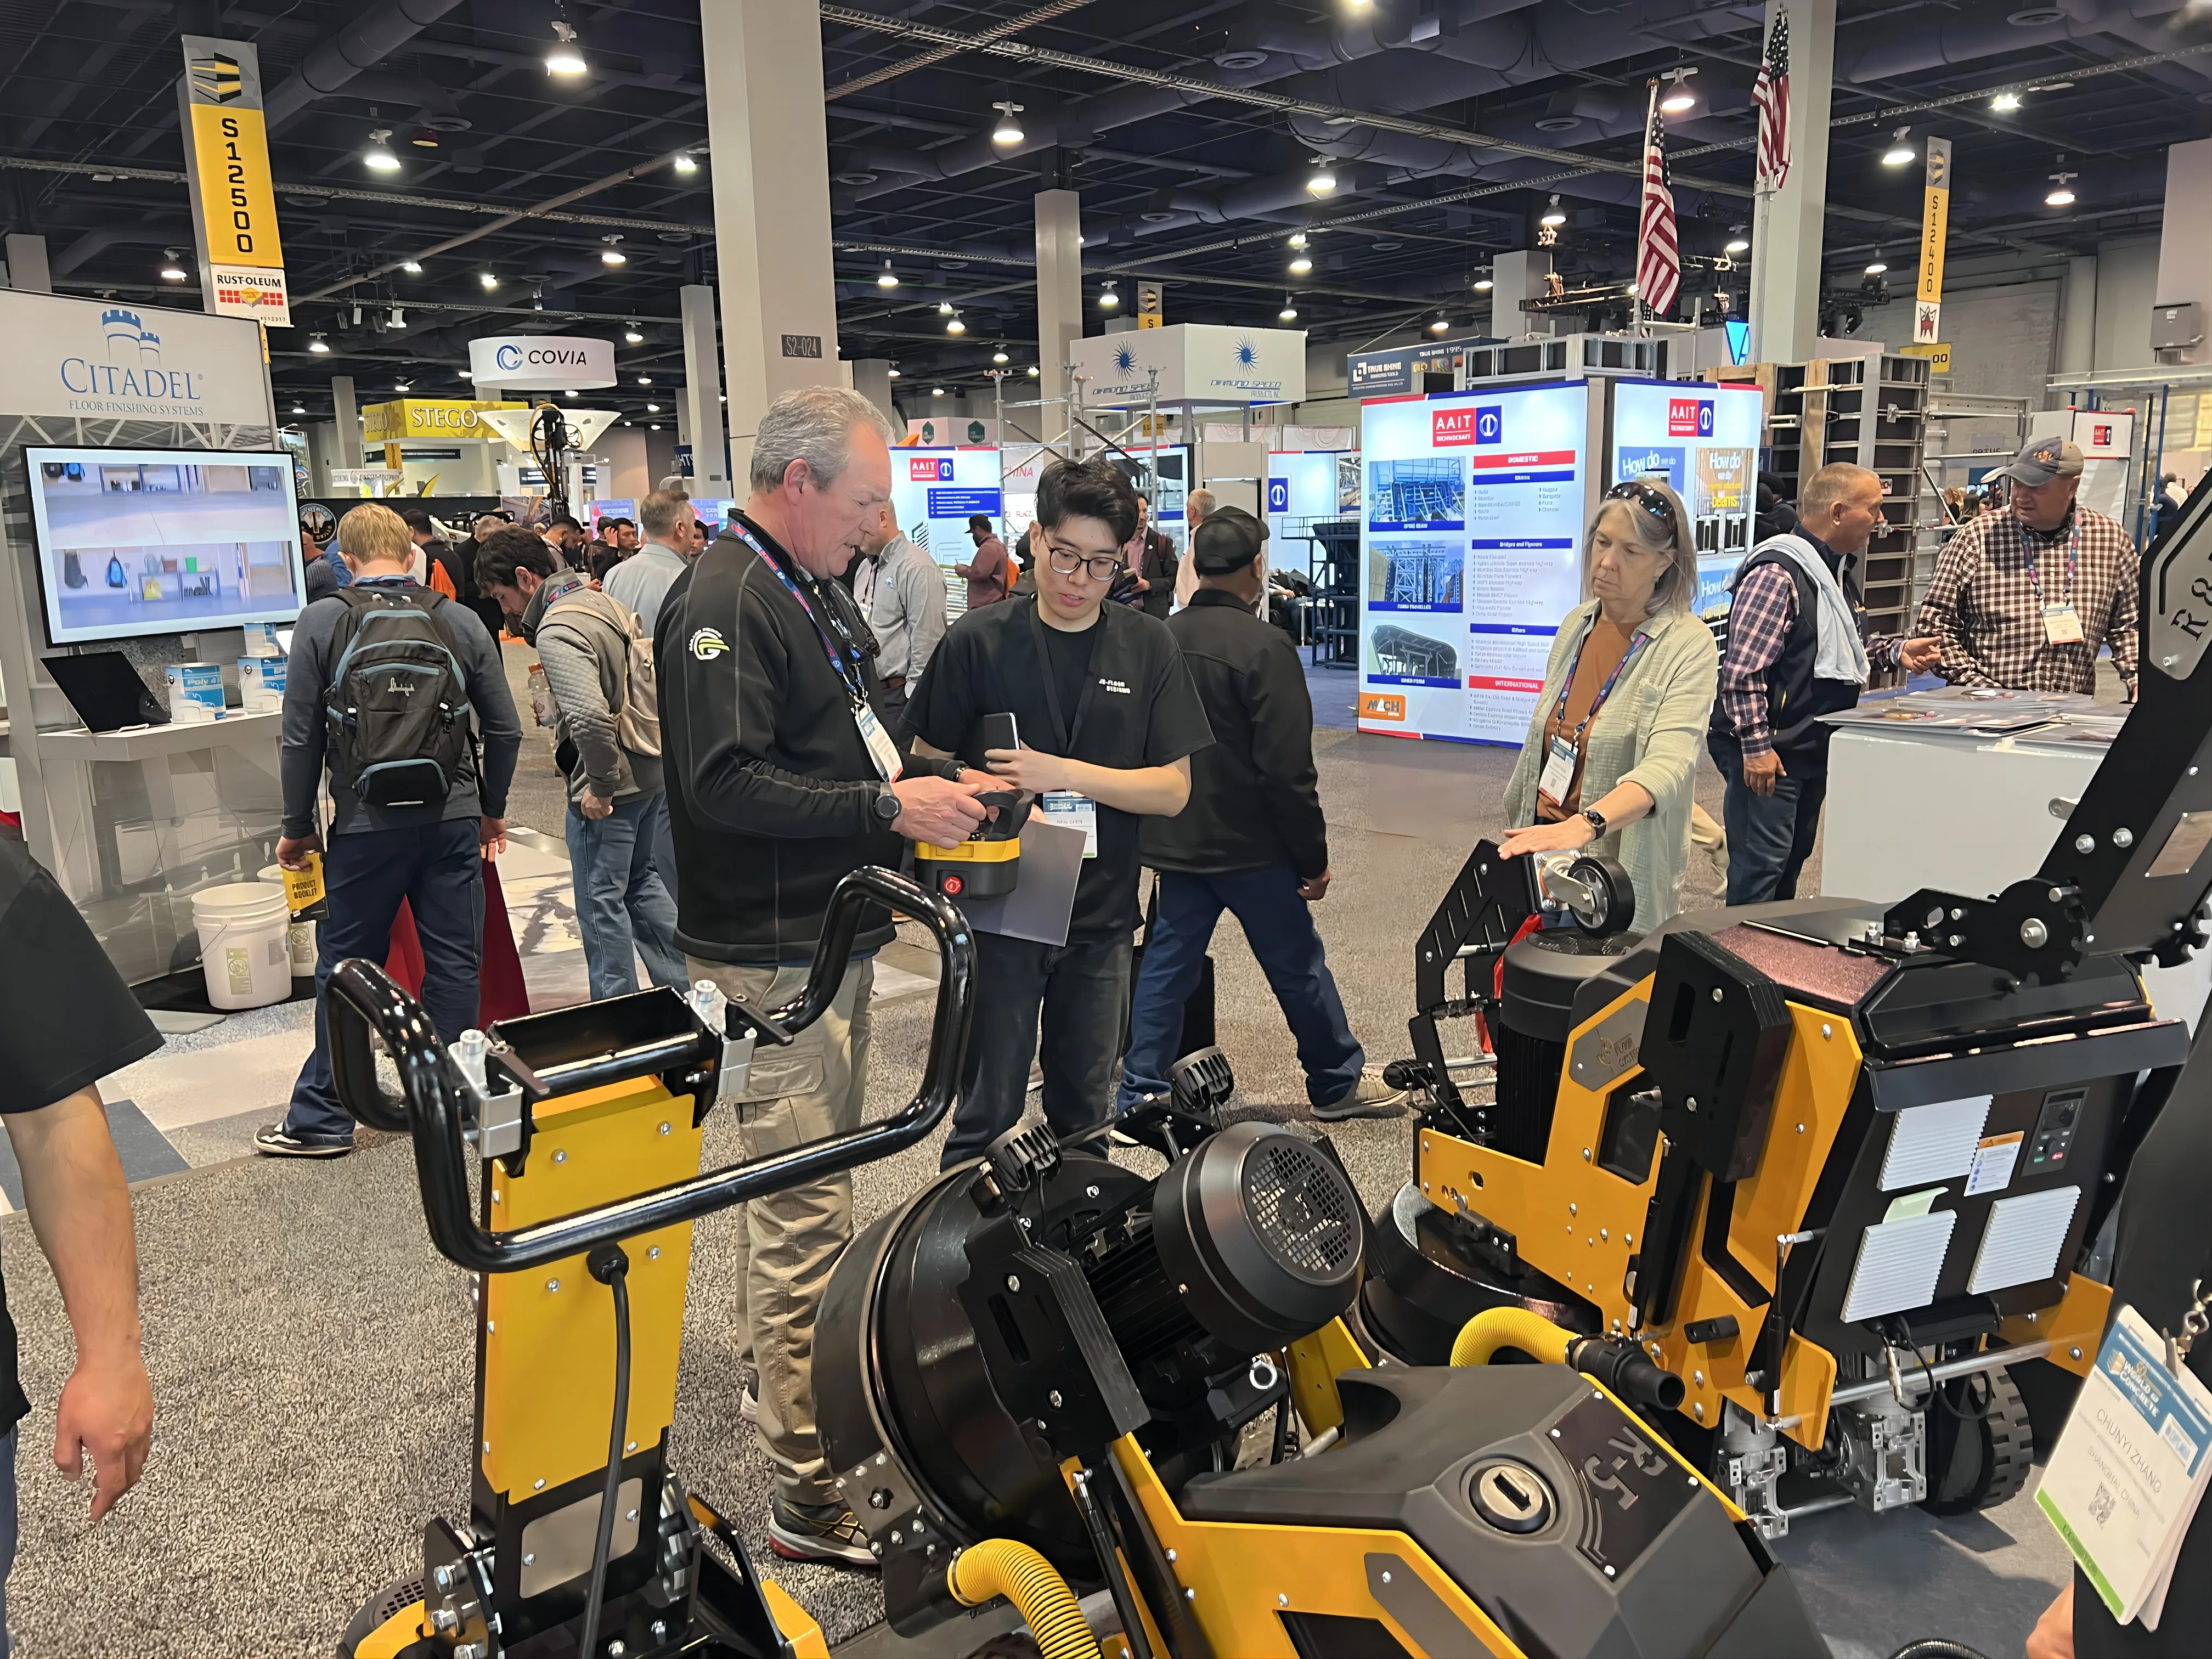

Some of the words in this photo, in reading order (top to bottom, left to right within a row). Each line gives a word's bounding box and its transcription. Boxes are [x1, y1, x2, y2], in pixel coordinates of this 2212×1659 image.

[221, 117, 253, 253] S12500
[1926, 195, 1939, 293] S12400
[217, 275, 281, 287] RUST-OLEUM
[786, 336, 817, 357] S2-024
[528, 350, 587, 365] COVIA
[70, 400, 104, 411] FLOOR
[106, 402, 157, 414] FINISHING
[159, 404, 204, 416] SYSTEMS
[1671, 406, 1695, 420] AAIT
[411, 408, 478, 427] STEGO
[1436, 415, 1471, 430] AAIT
[912, 462, 935, 471] AAIT
[1622, 457, 1645, 477] How
[1647, 449, 1660, 470] do
[1709, 452, 1728, 469] How
[1729, 451, 1742, 469] do
[2097, 1408, 2132, 1455] CHUNYI
